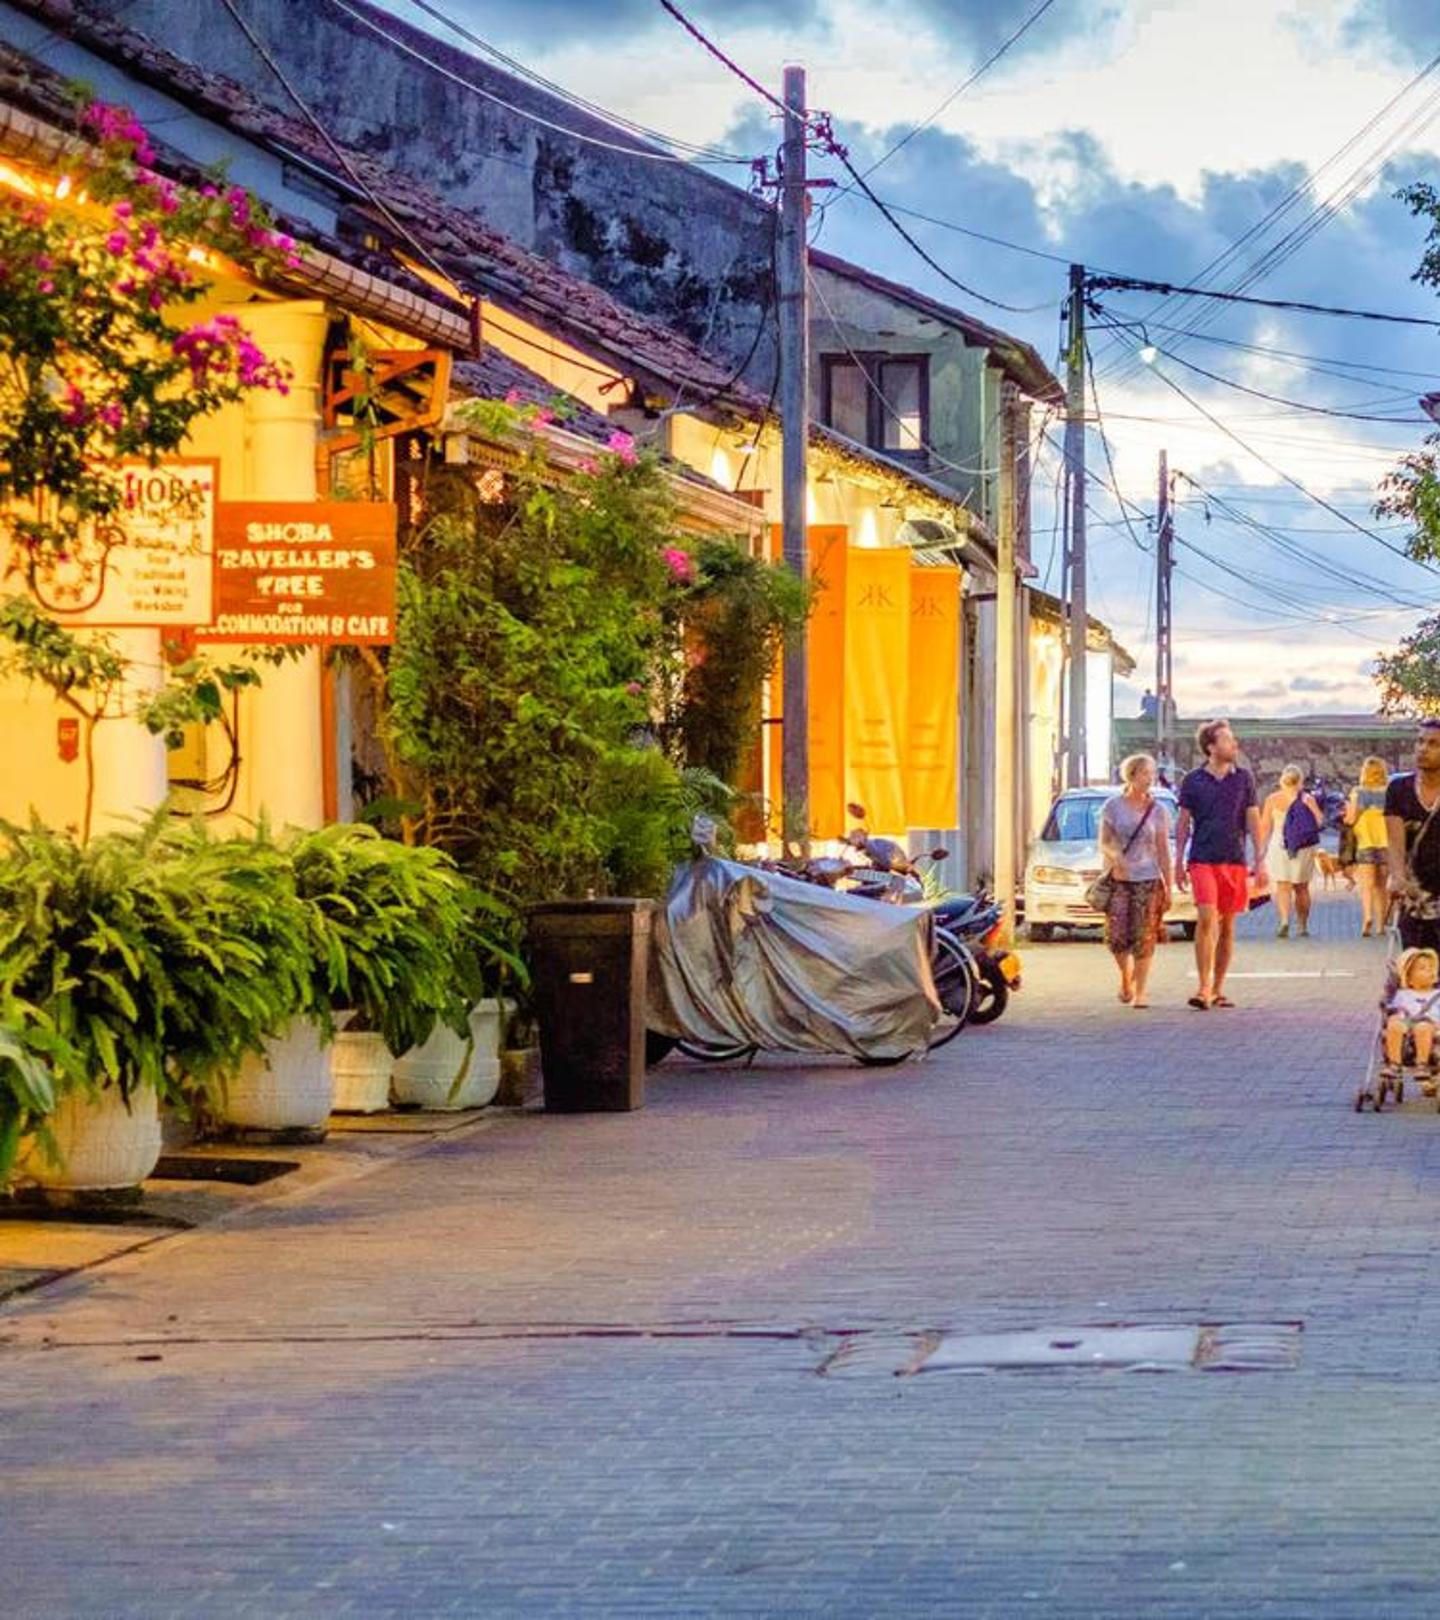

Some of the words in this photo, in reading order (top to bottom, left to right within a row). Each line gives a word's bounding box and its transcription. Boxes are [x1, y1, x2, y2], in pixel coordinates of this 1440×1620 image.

[118, 477, 206, 504] HOBA
[246, 522, 334, 543] SHOBA
[256, 576, 325, 596] TREE
[277, 602, 304, 615] FOR
[194, 614, 329, 636] COMMODATION
[347, 615, 390, 636] CAFE
